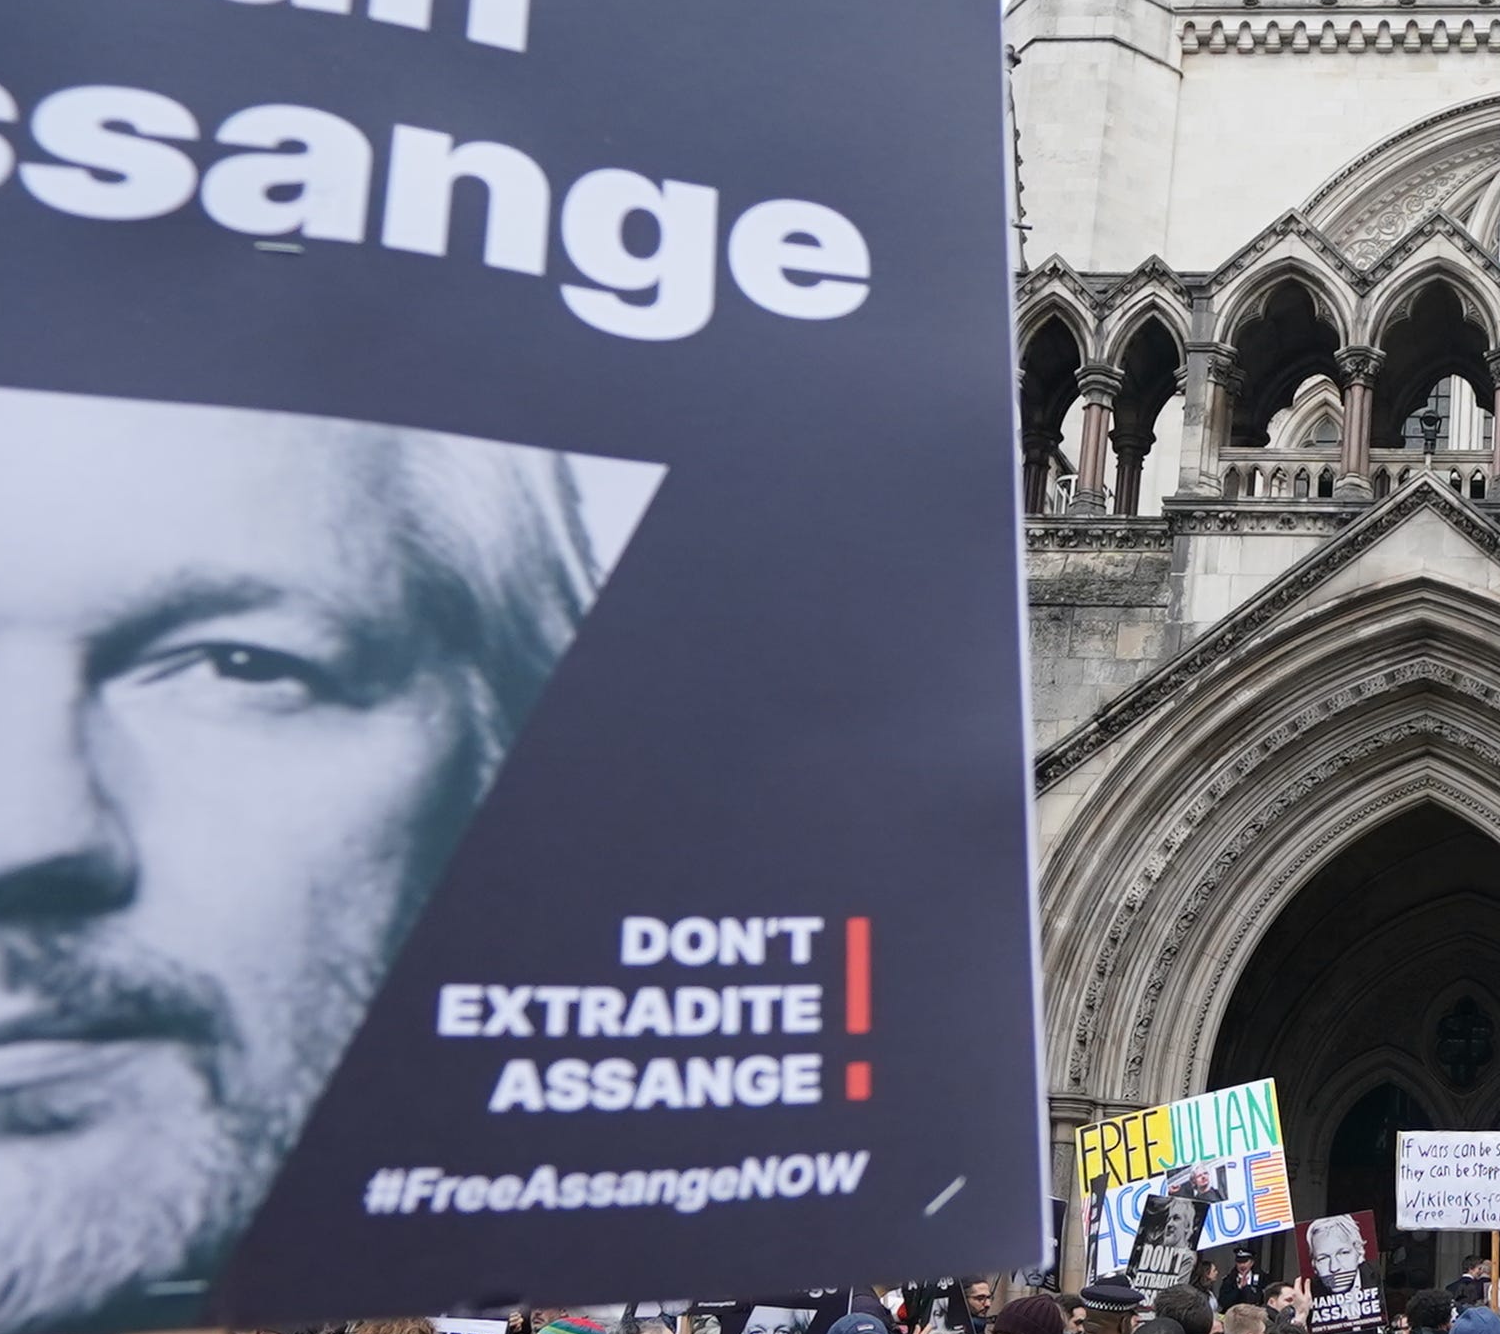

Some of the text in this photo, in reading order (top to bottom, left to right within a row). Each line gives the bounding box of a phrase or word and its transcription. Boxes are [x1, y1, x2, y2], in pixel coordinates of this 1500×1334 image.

[621, 916, 824, 966] DON'T
[437, 984, 823, 1037] EXTRADITE
[488, 1054, 822, 1112] ASSANGE
[1079, 1082, 1279, 1192] FREE JULIAN
[1418, 1142, 1448, 1158] wars
[1454, 1142, 1476, 1159] can
[1479, 1142, 1492, 1157] be
[365, 1151, 869, 1214] #FreeAssangeNOW
[1430, 1165, 1450, 1178] can
[1456, 1163, 1470, 1177] be
[1138, 1243, 1183, 1274] DON'T
[1311, 1287, 1378, 1309] HANDS OFF
[1311, 1300, 1381, 1324] ASSANGE
